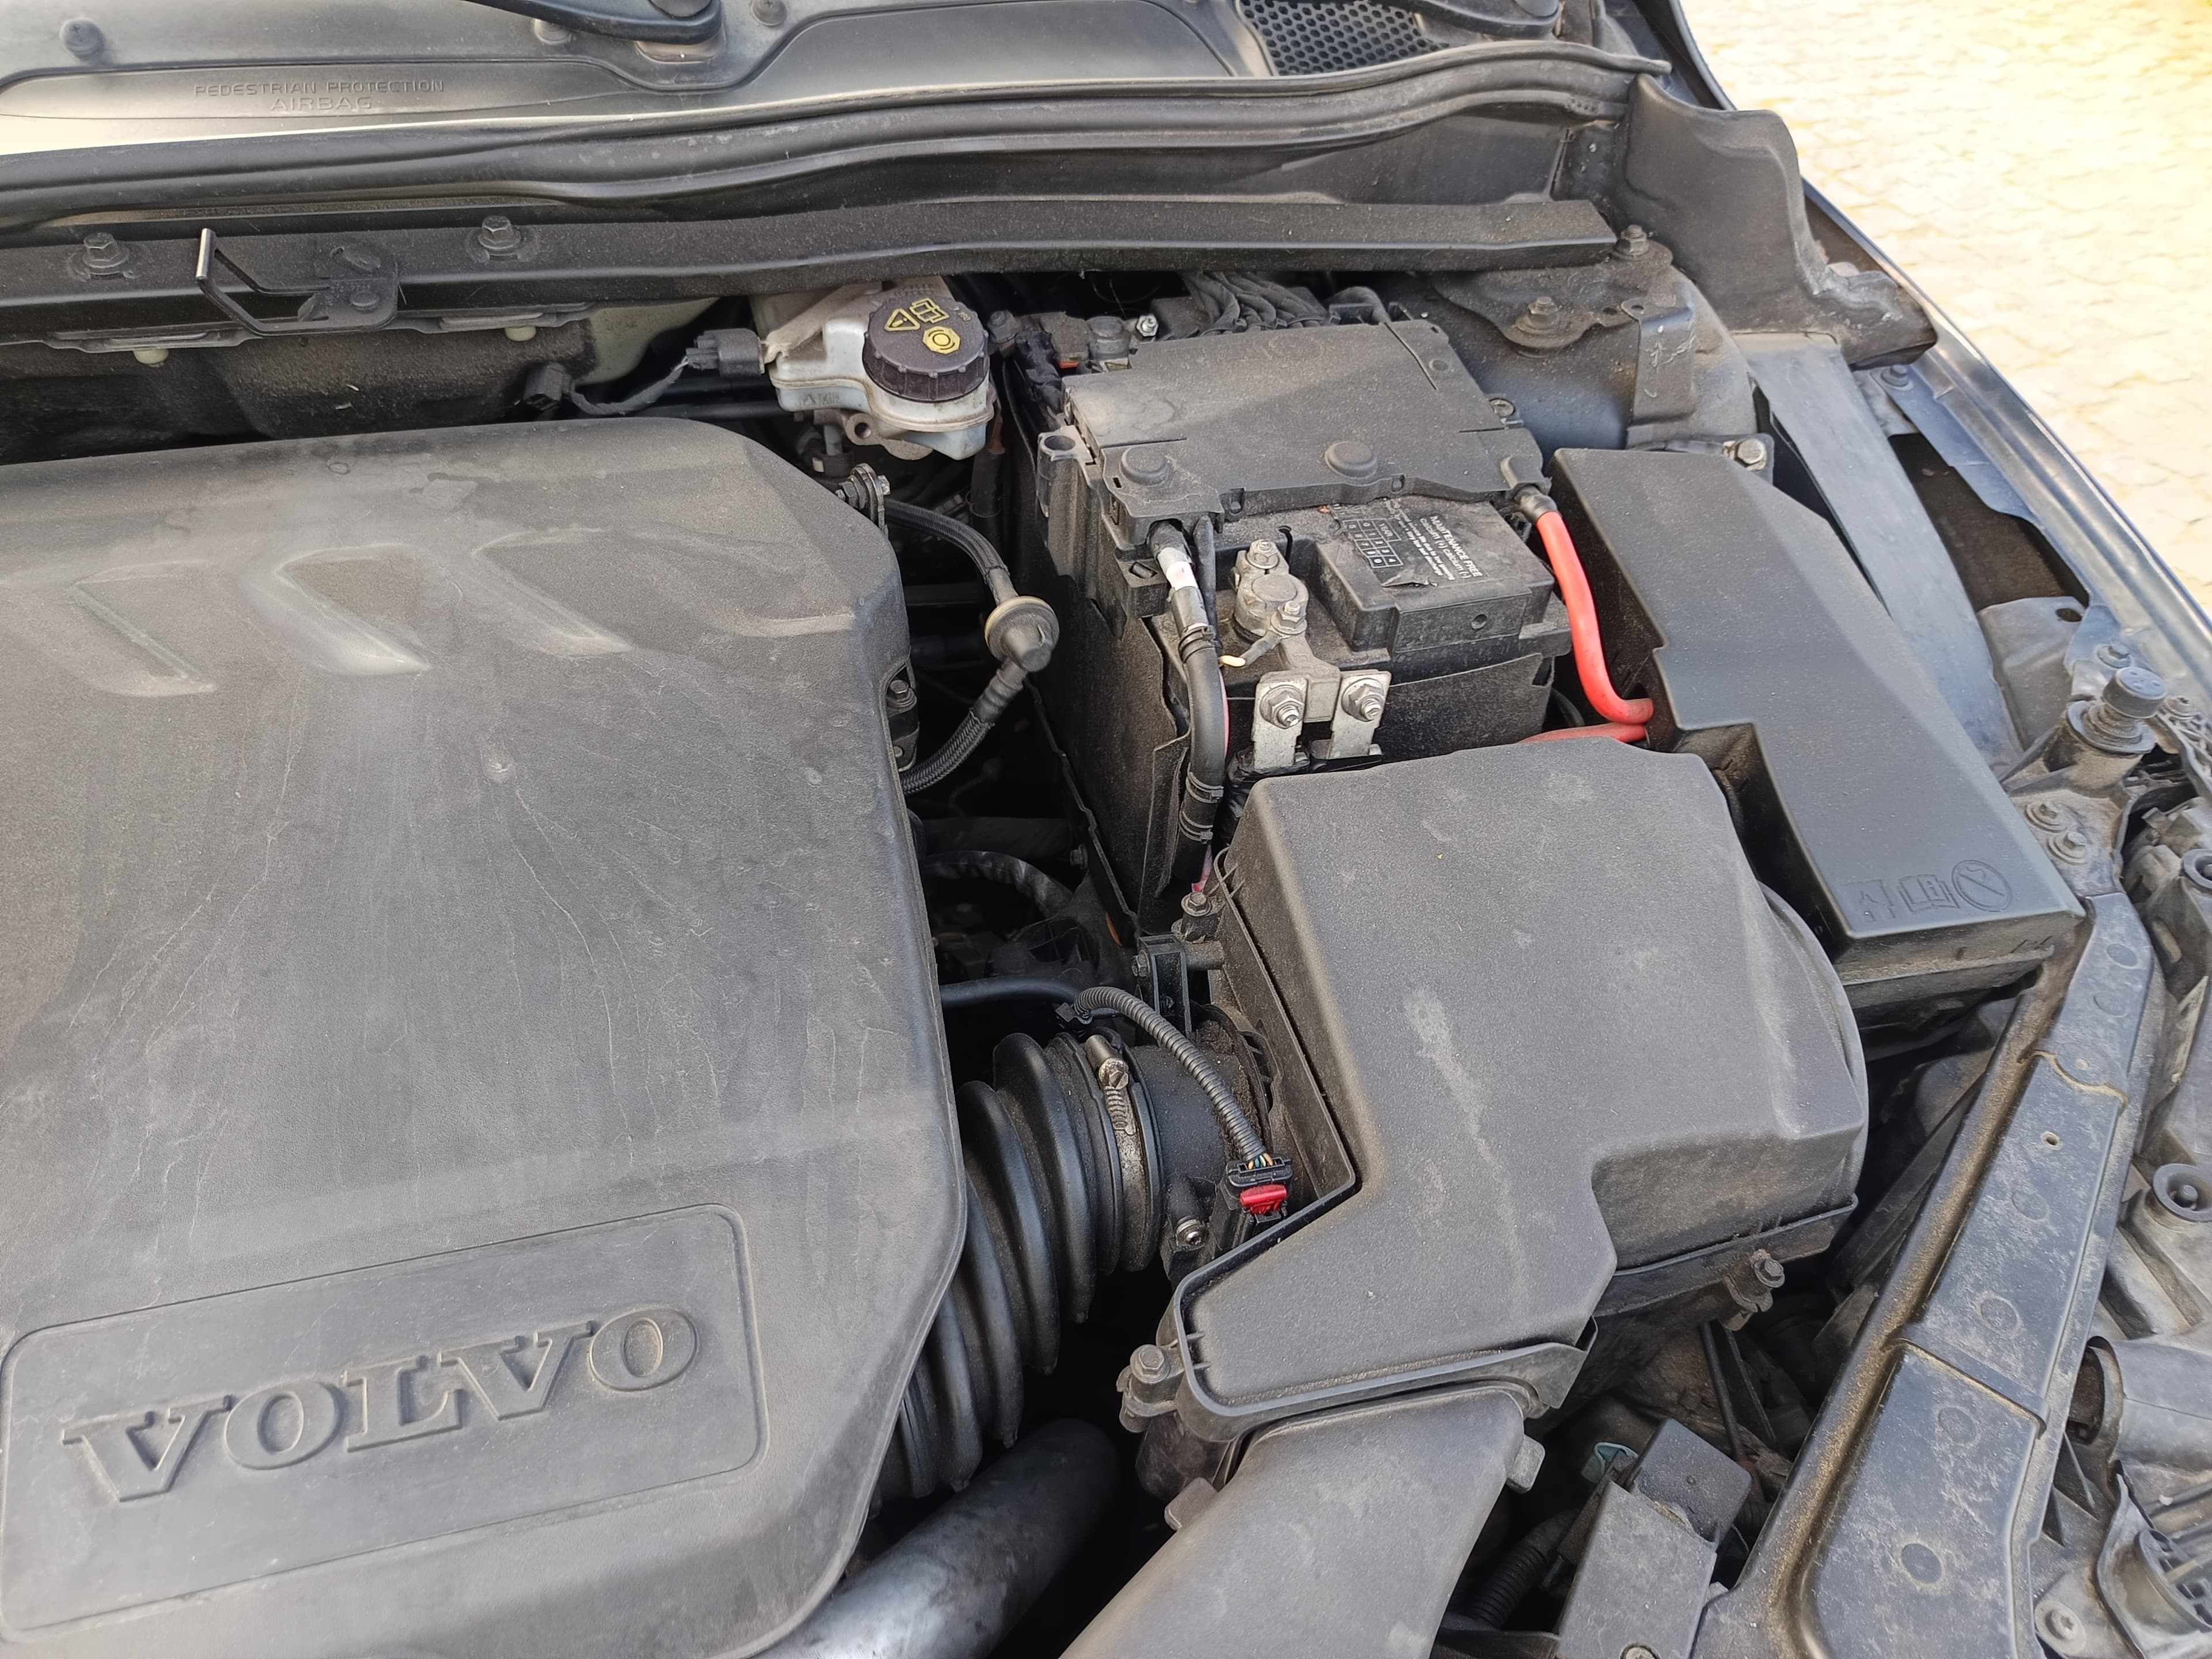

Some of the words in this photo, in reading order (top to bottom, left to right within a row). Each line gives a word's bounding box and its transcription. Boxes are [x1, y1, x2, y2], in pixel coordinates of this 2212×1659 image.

[194, 82, 317, 97] PEDESTRIAN
[326, 80, 444, 93] PROTECTION
[270, 96, 373, 111] AIRBAG
[1430, 516, 1469, 560] MAINTENANCE
[1463, 560, 1483, 577] FREE
[62, 1305, 699, 1502] VOLVO
